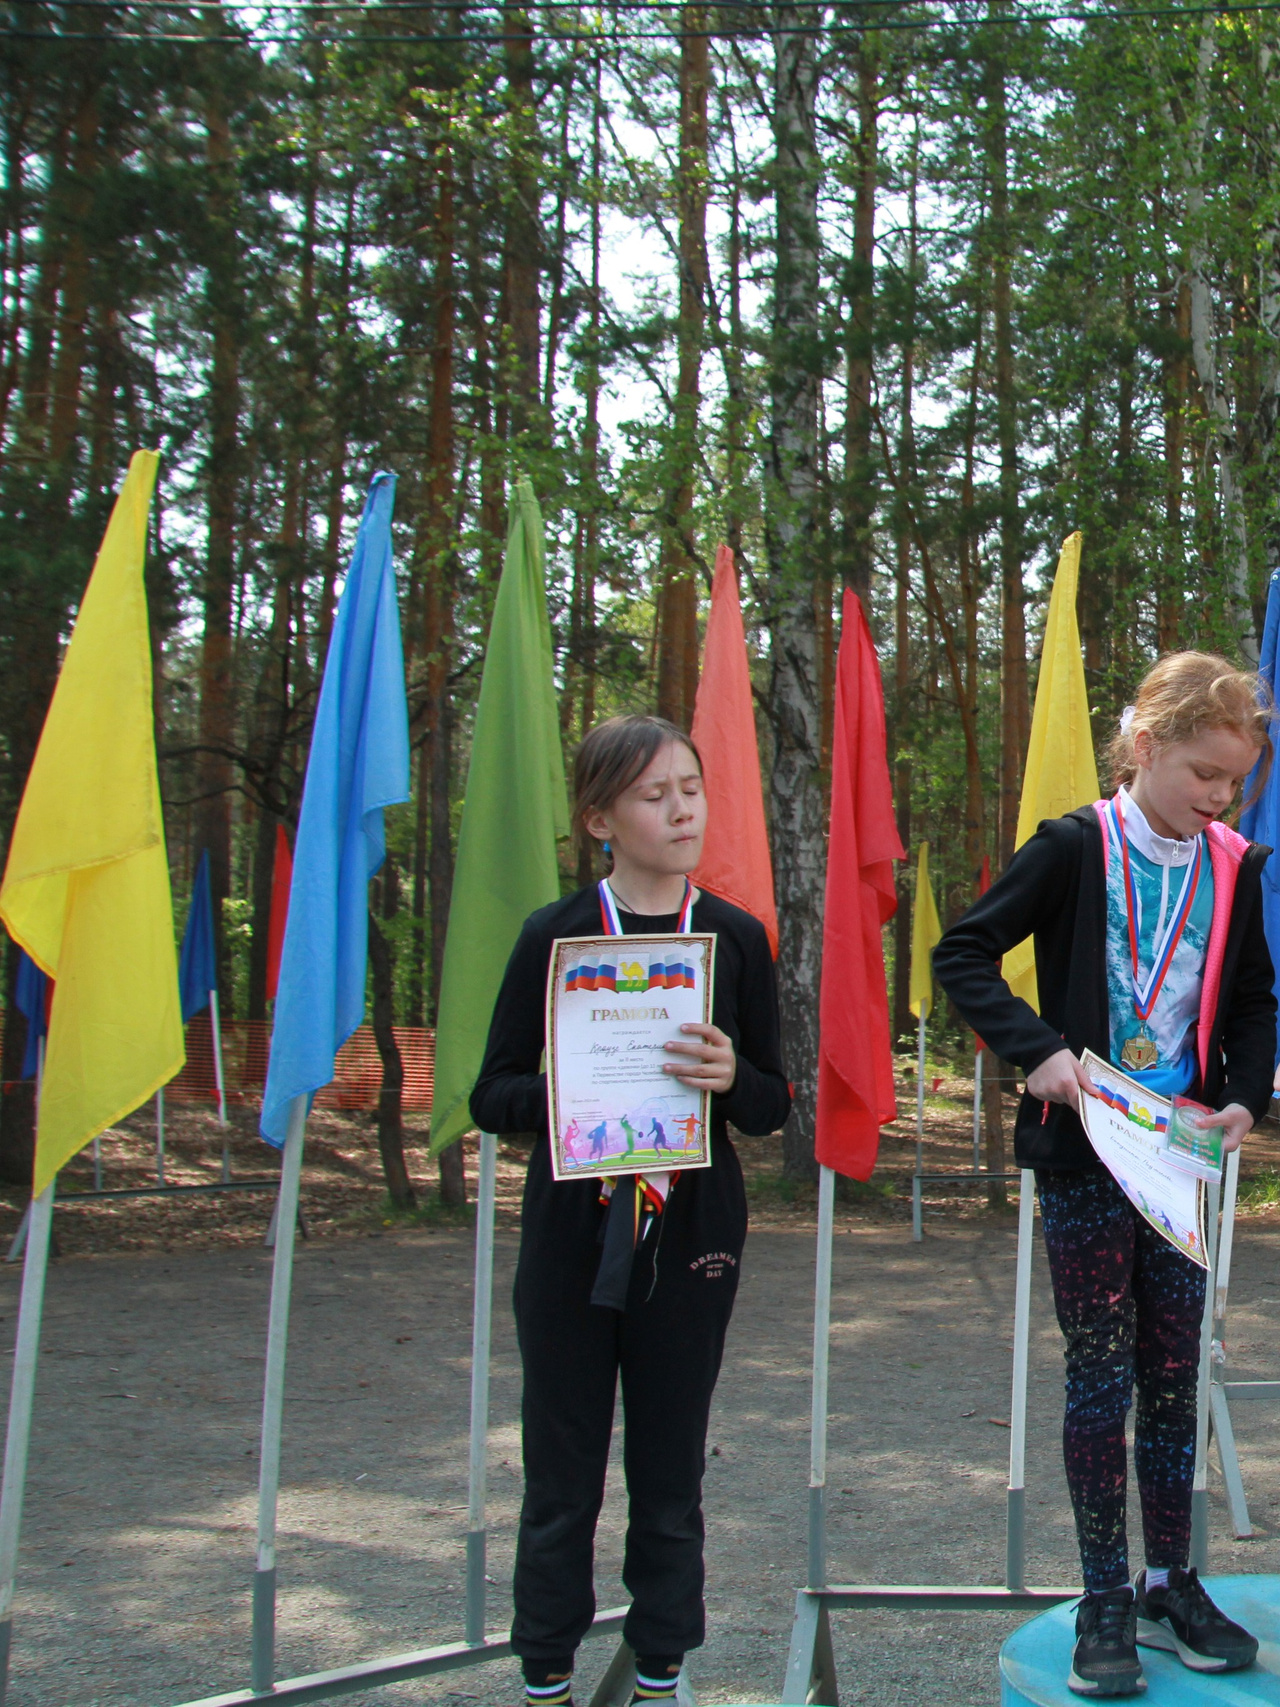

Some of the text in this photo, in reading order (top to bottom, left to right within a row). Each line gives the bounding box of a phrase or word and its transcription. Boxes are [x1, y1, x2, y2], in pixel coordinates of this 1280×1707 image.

[591, 1008, 669, 1021] ГРАМОТА
[1136, 1050, 1142, 1060] 1
[690, 1252, 736, 1271] DREAMER
[706, 1270, 723, 1278] DAY
